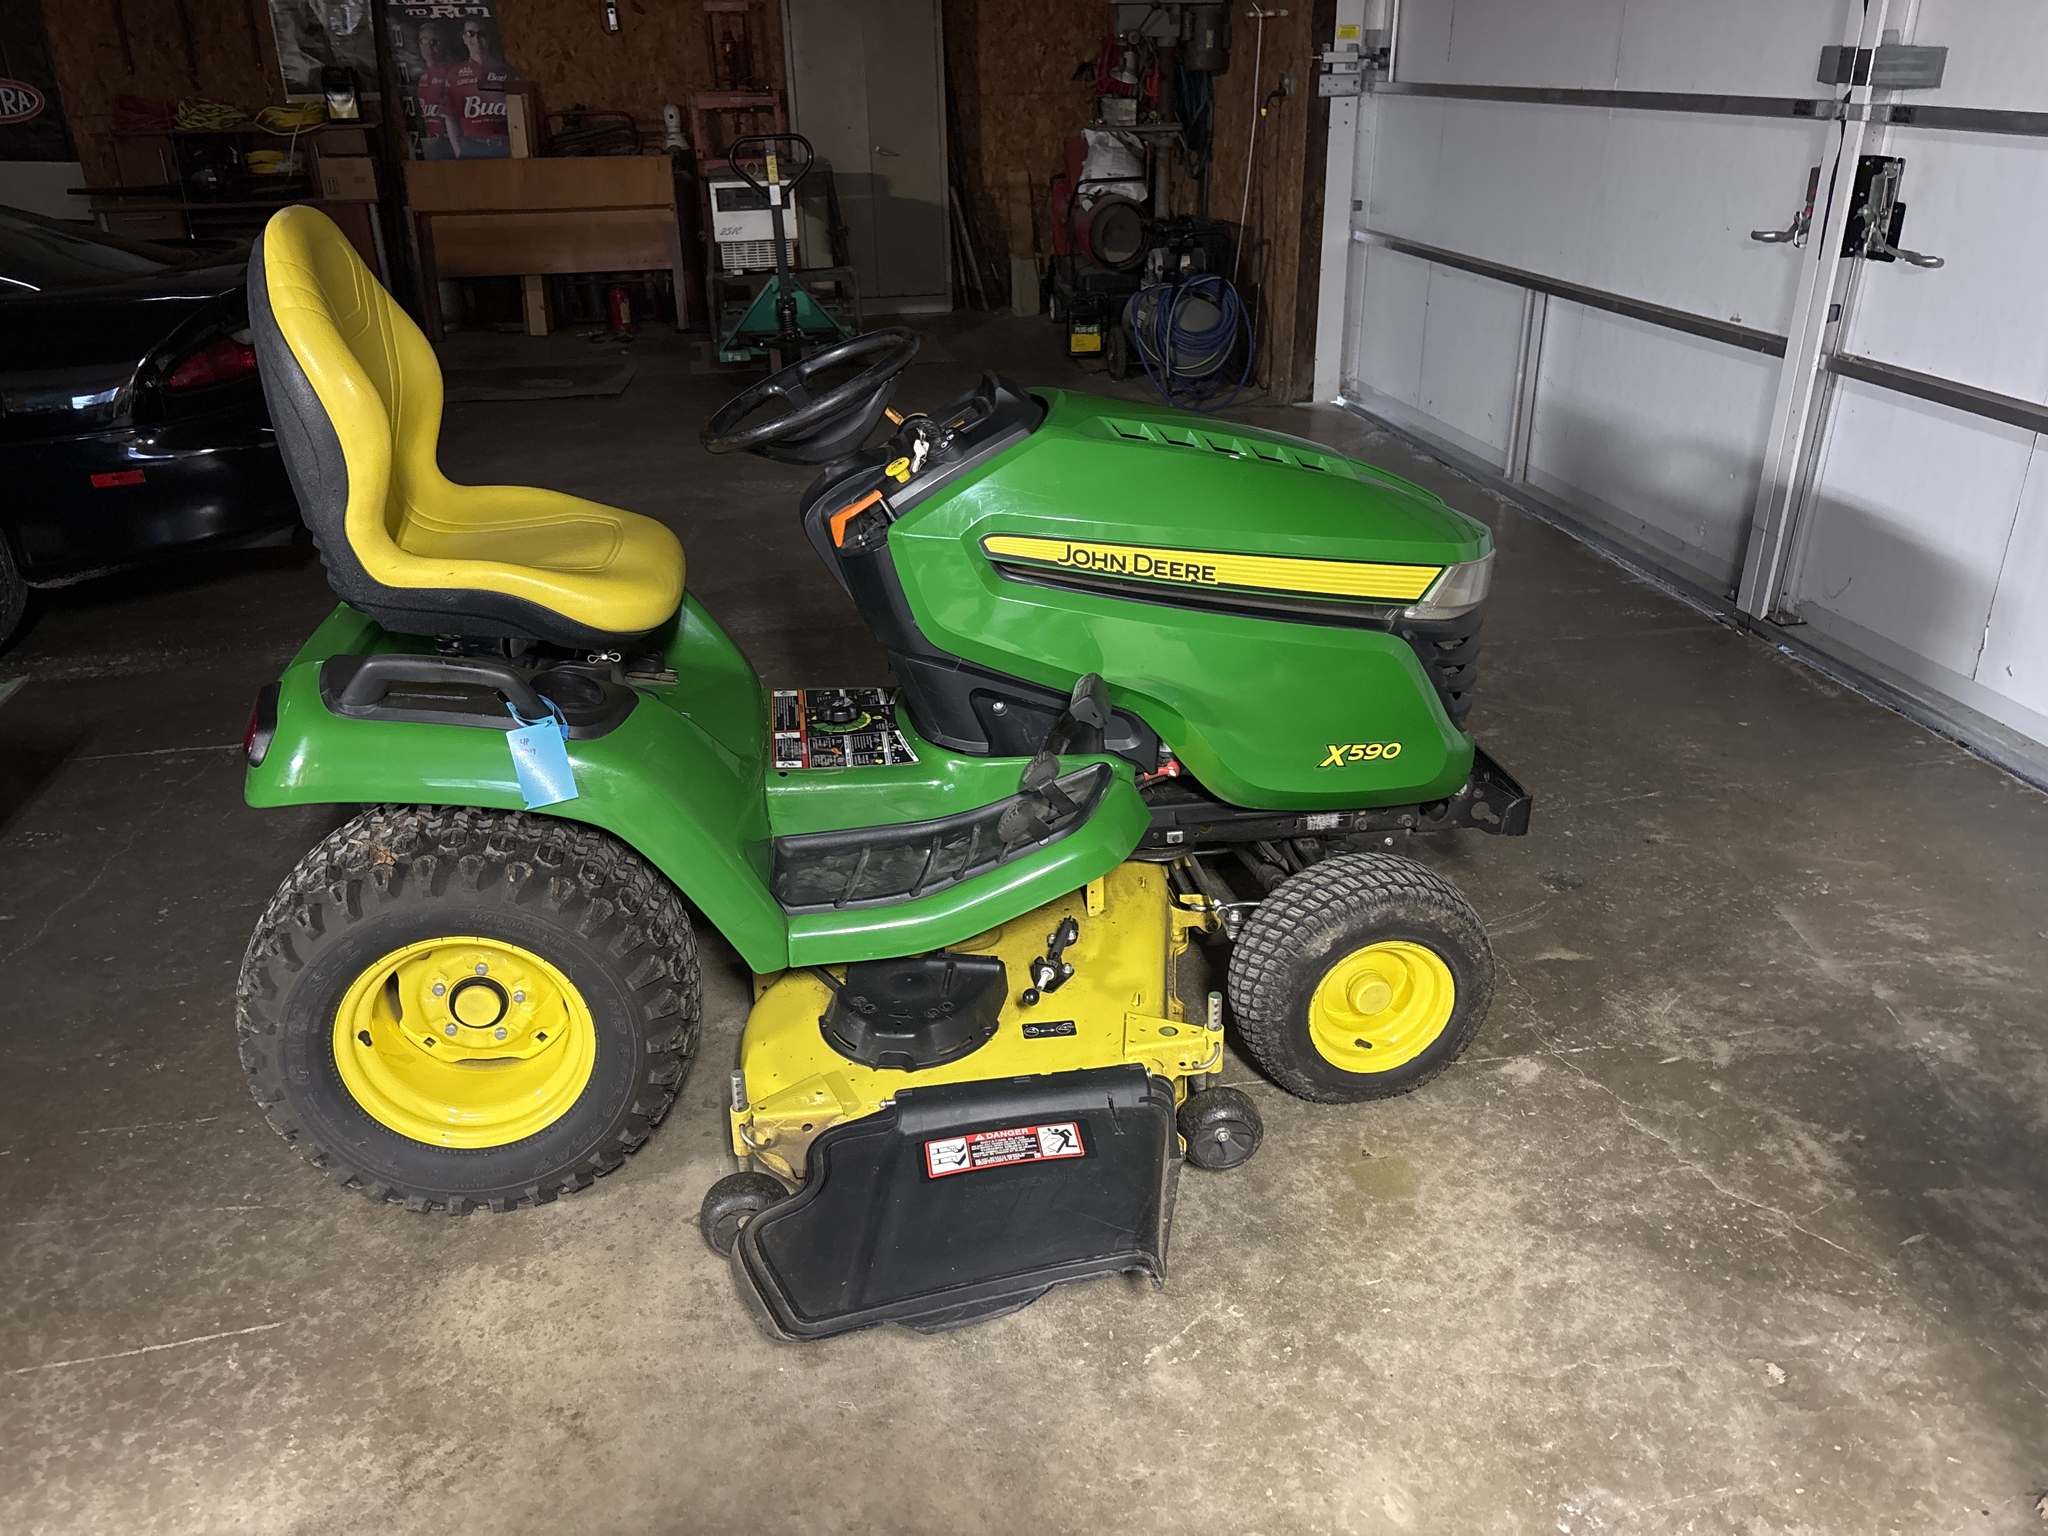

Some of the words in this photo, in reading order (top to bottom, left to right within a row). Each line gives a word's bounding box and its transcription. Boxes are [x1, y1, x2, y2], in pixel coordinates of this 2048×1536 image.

[0, 88, 31, 115] RA
[1057, 544, 1130, 574] JOHN
[1132, 553, 1217, 584] DEERE
[1317, 740, 1402, 769] X590
[985, 1127, 1030, 1140] DANGER
